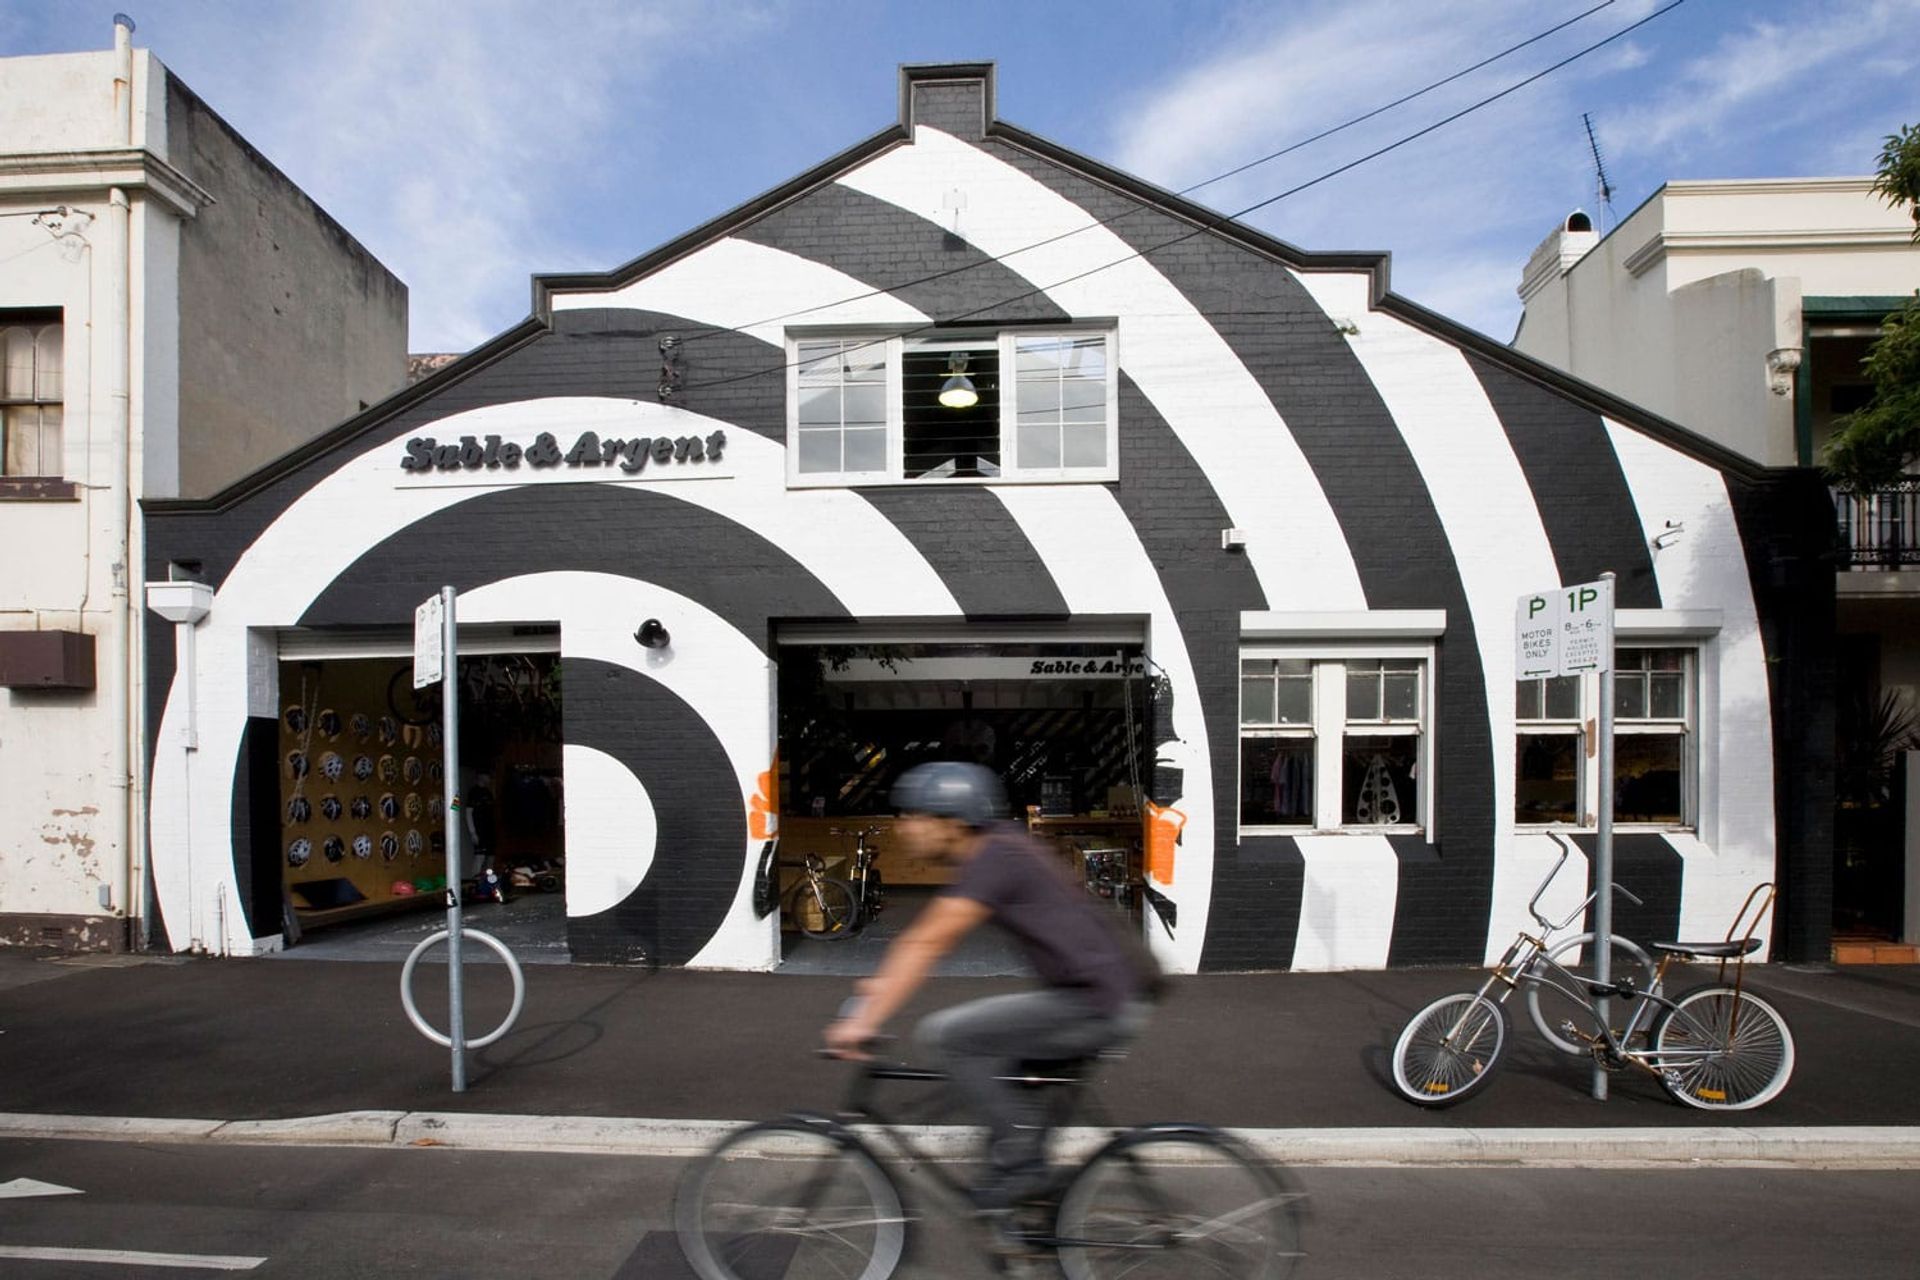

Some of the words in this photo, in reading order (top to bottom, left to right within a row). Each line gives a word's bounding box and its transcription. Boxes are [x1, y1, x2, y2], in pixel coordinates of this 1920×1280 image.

[1567, 587, 1597, 612] 1P
[1529, 596, 1546, 619] P
[1522, 629, 1552, 639] MOTOR
[1523, 639, 1551, 650] BIKES
[1526, 649, 1548, 659] ONLY
